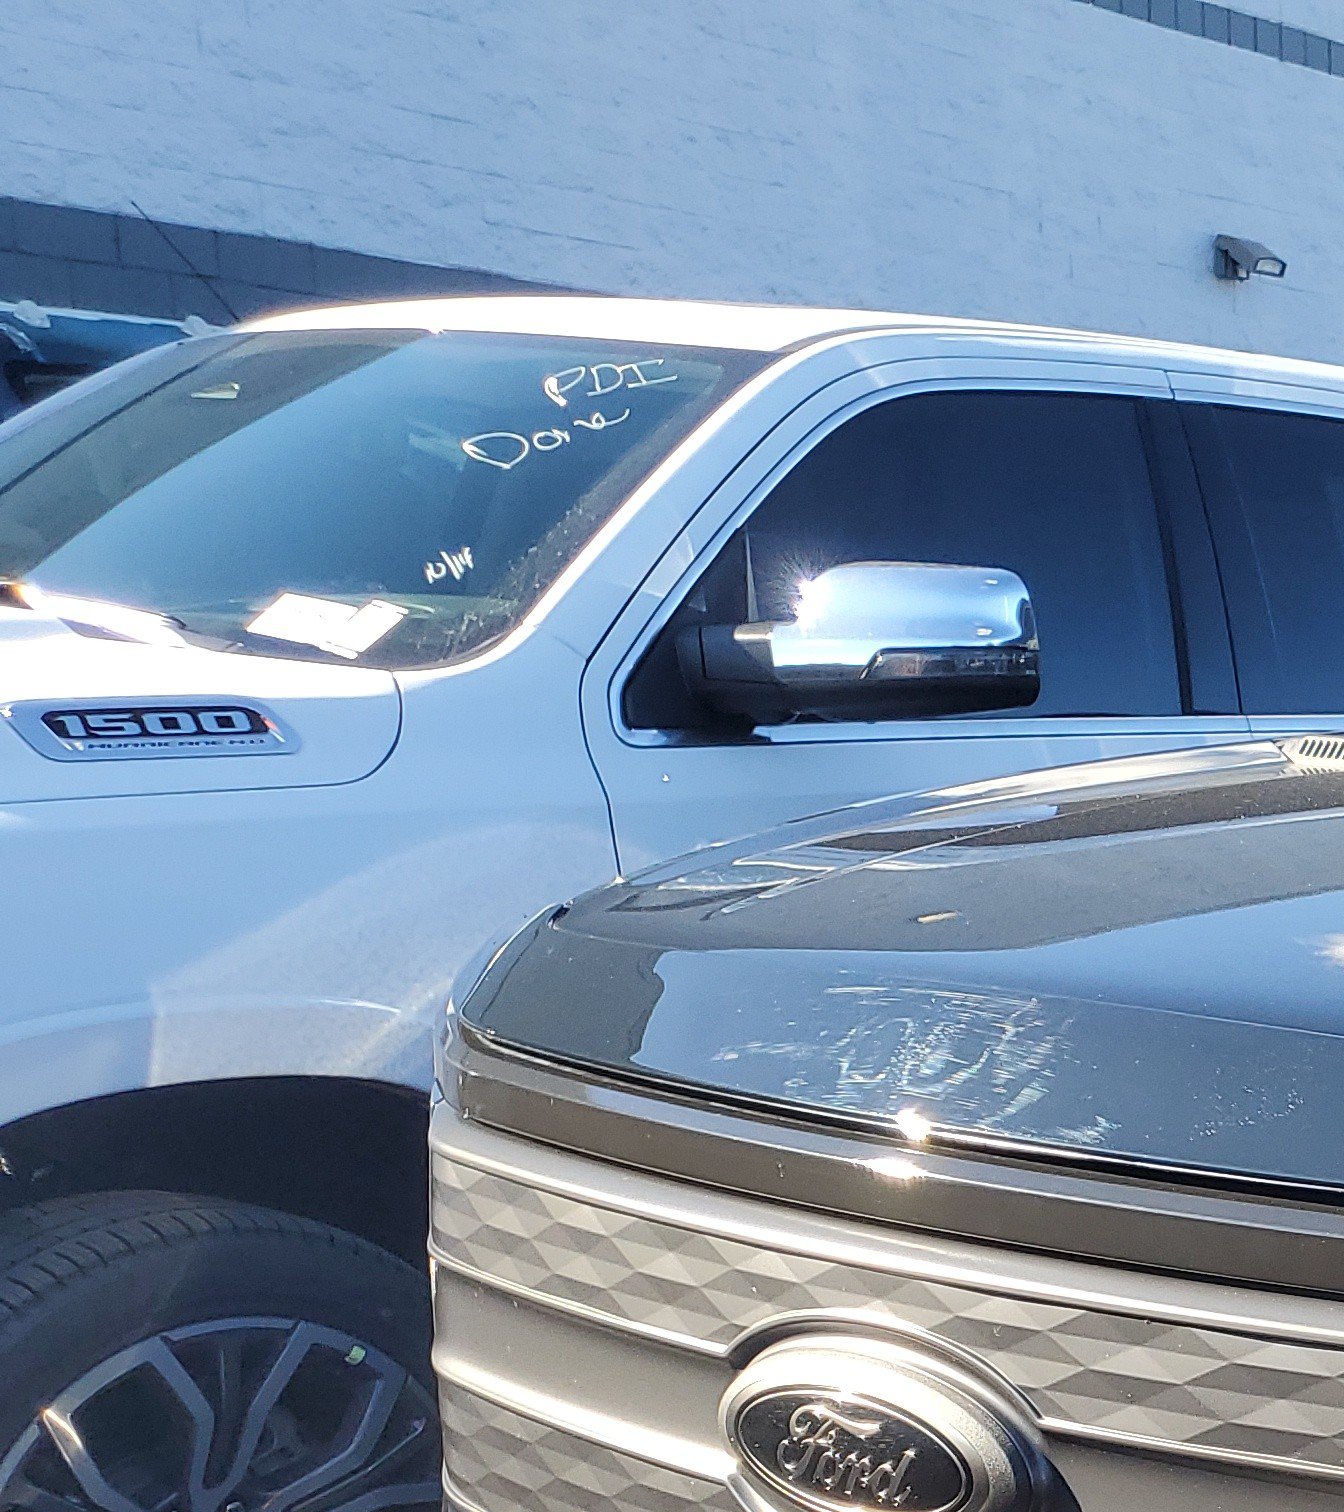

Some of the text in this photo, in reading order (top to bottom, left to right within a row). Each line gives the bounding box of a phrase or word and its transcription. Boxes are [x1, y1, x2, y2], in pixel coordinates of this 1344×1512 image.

[544, 358, 678, 406] PDI
[462, 408, 631, 469] Done
[54, 710, 251, 738] 1500
[776, 1403, 918, 1506] Ford
